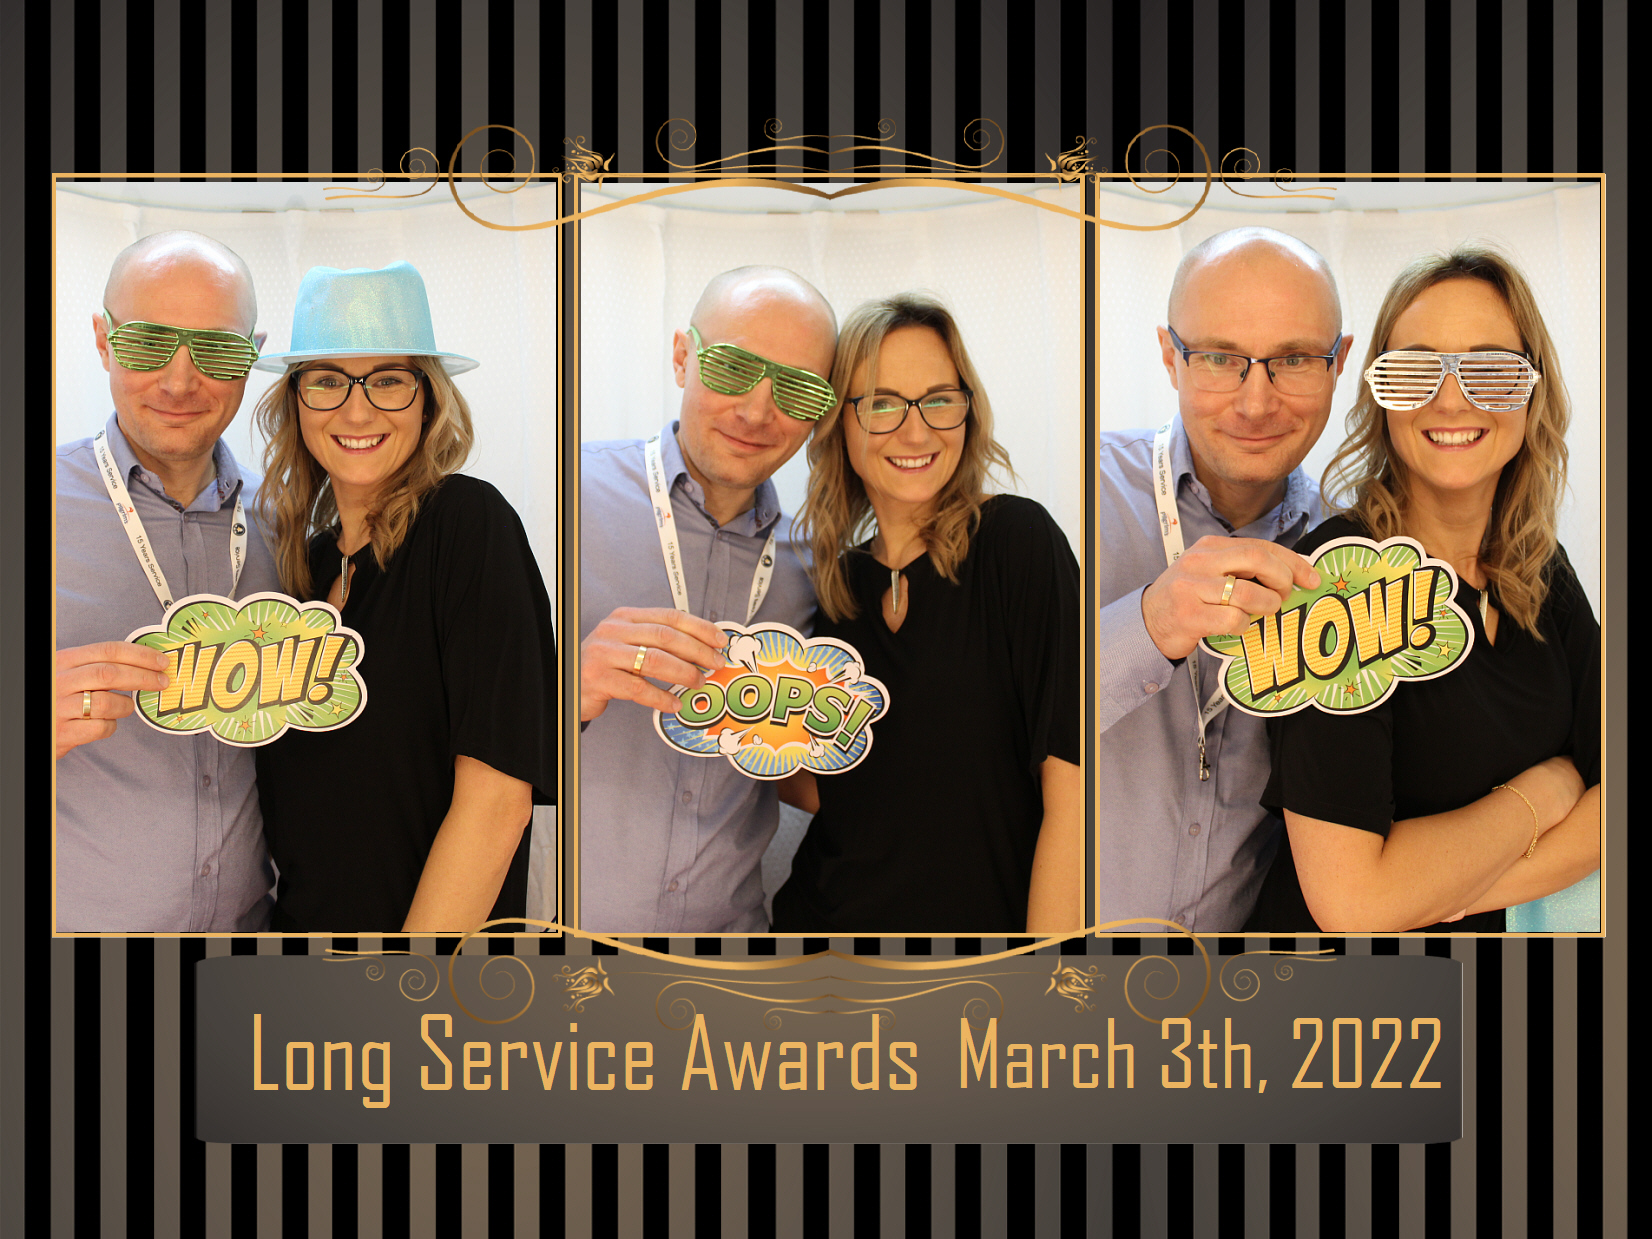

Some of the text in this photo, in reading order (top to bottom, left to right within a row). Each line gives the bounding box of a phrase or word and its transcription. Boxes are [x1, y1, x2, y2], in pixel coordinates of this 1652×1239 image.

[100, 454, 109, 468] Years
[106, 468, 118, 490] Service
[652, 472, 661, 493] Service
[1159, 470, 1167, 496] Service
[116, 502, 129, 525] Pilgrims
[135, 535, 163, 587] 15 Years Service
[667, 541, 682, 596] 15 Years Service
[1173, 551, 1180, 561] 15
[754, 577, 764, 598] Service
[1240, 565, 1441, 702] WOW!
[157, 633, 352, 717] WOW!
[675, 673, 877, 751] OOPS!
[1204, 694, 1225, 715] 15 Year
